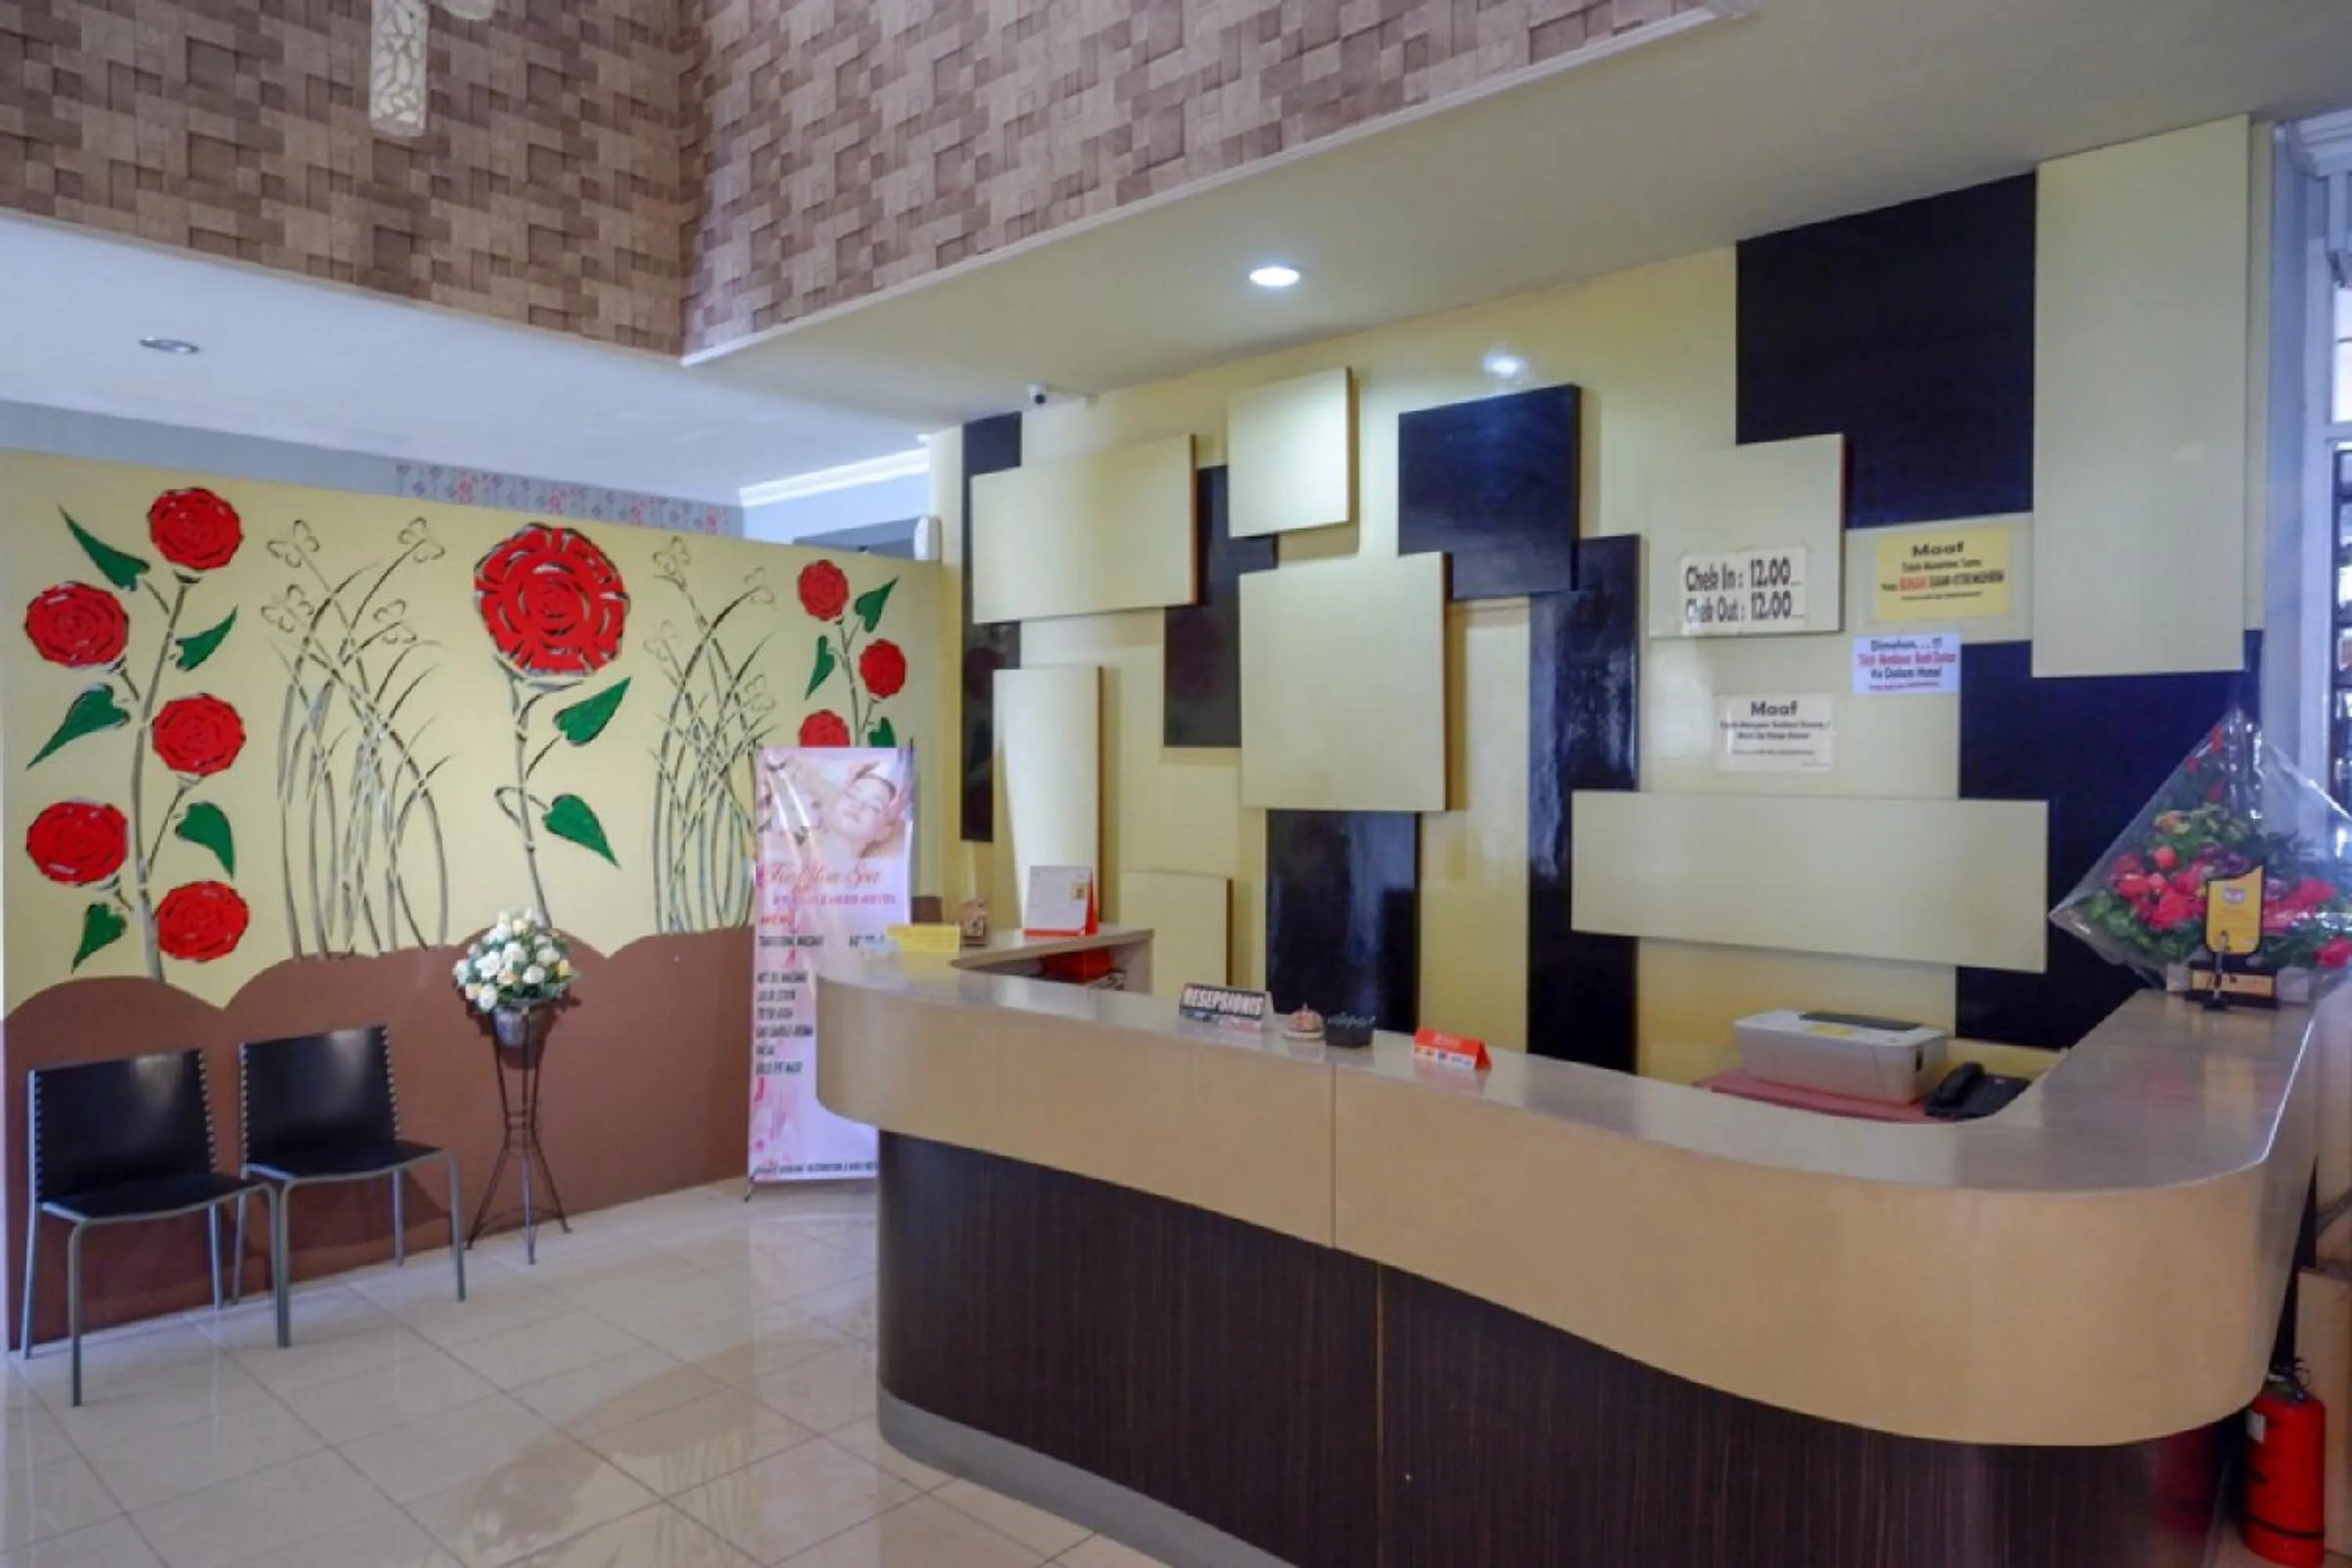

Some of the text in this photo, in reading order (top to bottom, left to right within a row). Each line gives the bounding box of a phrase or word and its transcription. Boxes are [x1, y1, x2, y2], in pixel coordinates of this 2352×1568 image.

[1722, 562, 1736, 590] In
[1718, 594, 1738, 622] Out
[1751, 700, 1798, 717] Maaf
